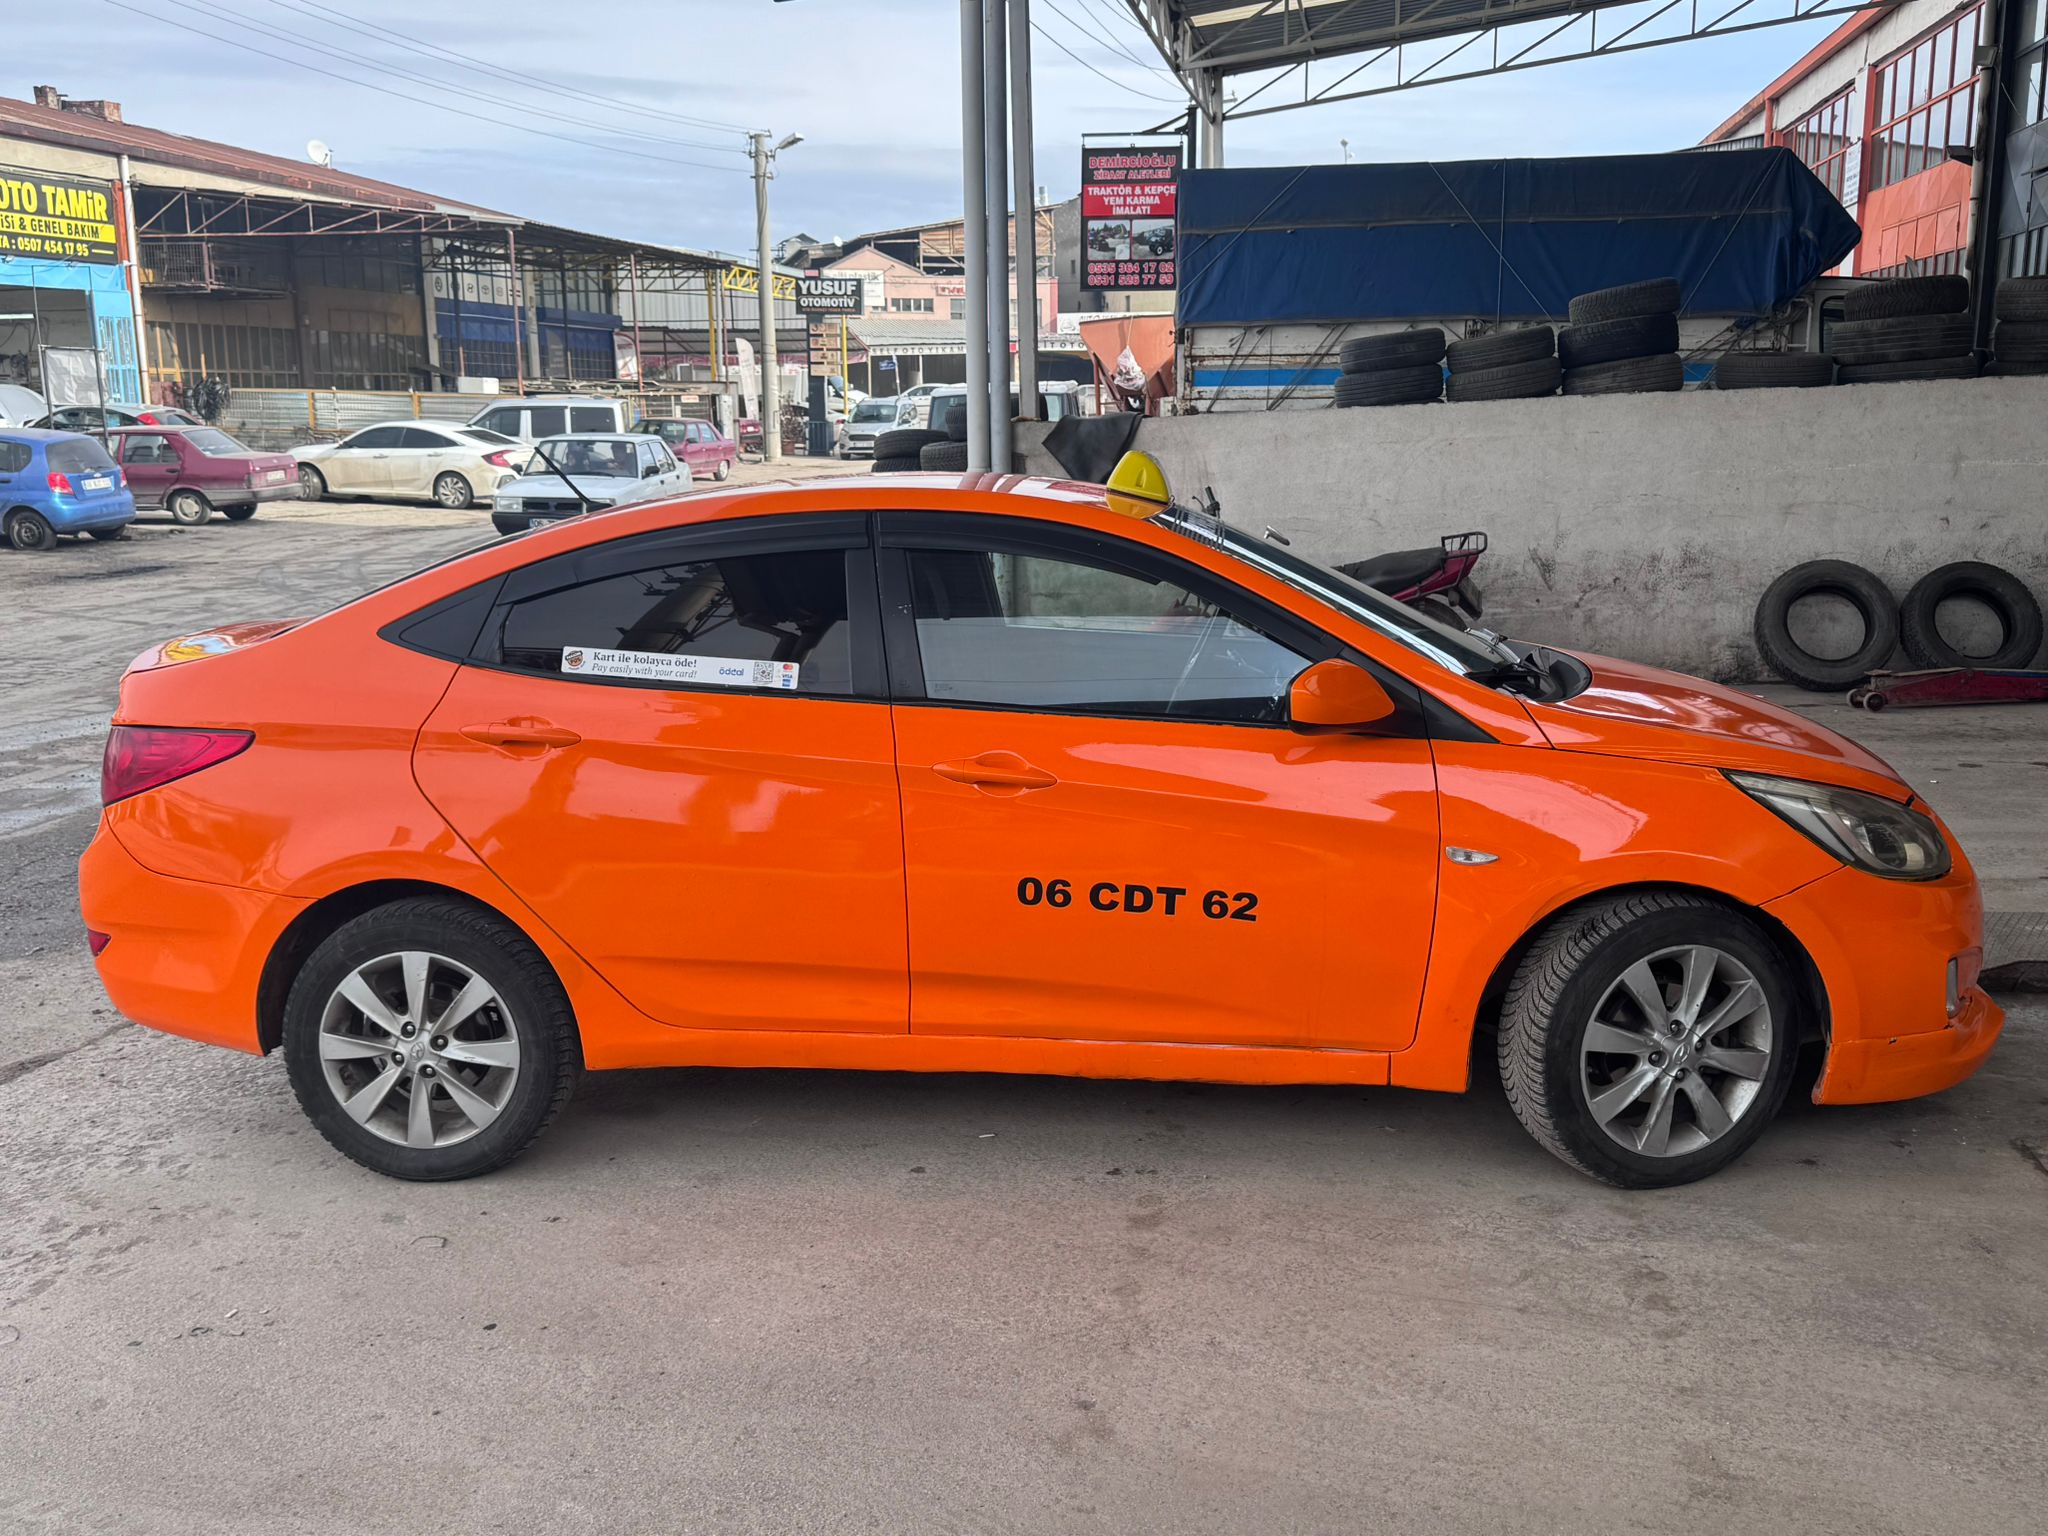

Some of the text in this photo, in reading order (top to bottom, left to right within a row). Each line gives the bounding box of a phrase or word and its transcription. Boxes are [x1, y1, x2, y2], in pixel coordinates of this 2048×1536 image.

[1088, 153, 1176, 168] DEMİRCİOĞLU
[1088, 184, 1176, 197] TRAKTÖR & KEPÇE
[1103, 196, 1160, 205] YEM KARMA
[1112, 206, 1151, 215] İMALATI
[18, 216, 27, 231] &
[30, 218, 64, 235] GENEL
[66, 222, 100, 239] BAKIM
[17, 237, 42, 252] 0507
[44, 240, 63, 254] 454
[65, 242, 75, 255] 17
[76, 243, 89, 257] 95
[1142, 262, 1157, 273] 17
[797, 280, 857, 295] YUSUF
[1087, 274, 1115, 286] 0531
[1142, 274, 1157, 285] 77
[800, 295, 855, 307] OTOMOTİV
[593, 651, 615, 662] Kart
[618, 653, 631, 663] ile
[633, 654, 672, 668] kolayca
[675, 657, 697, 668] öde!
[592, 662, 608, 674] Pay
[609, 664, 634, 675] easily
[635, 666, 654, 676] with
[656, 669, 673, 679] your
[675, 668, 698, 679] card!
[1017, 877, 1258, 922] 06 CDT 62
